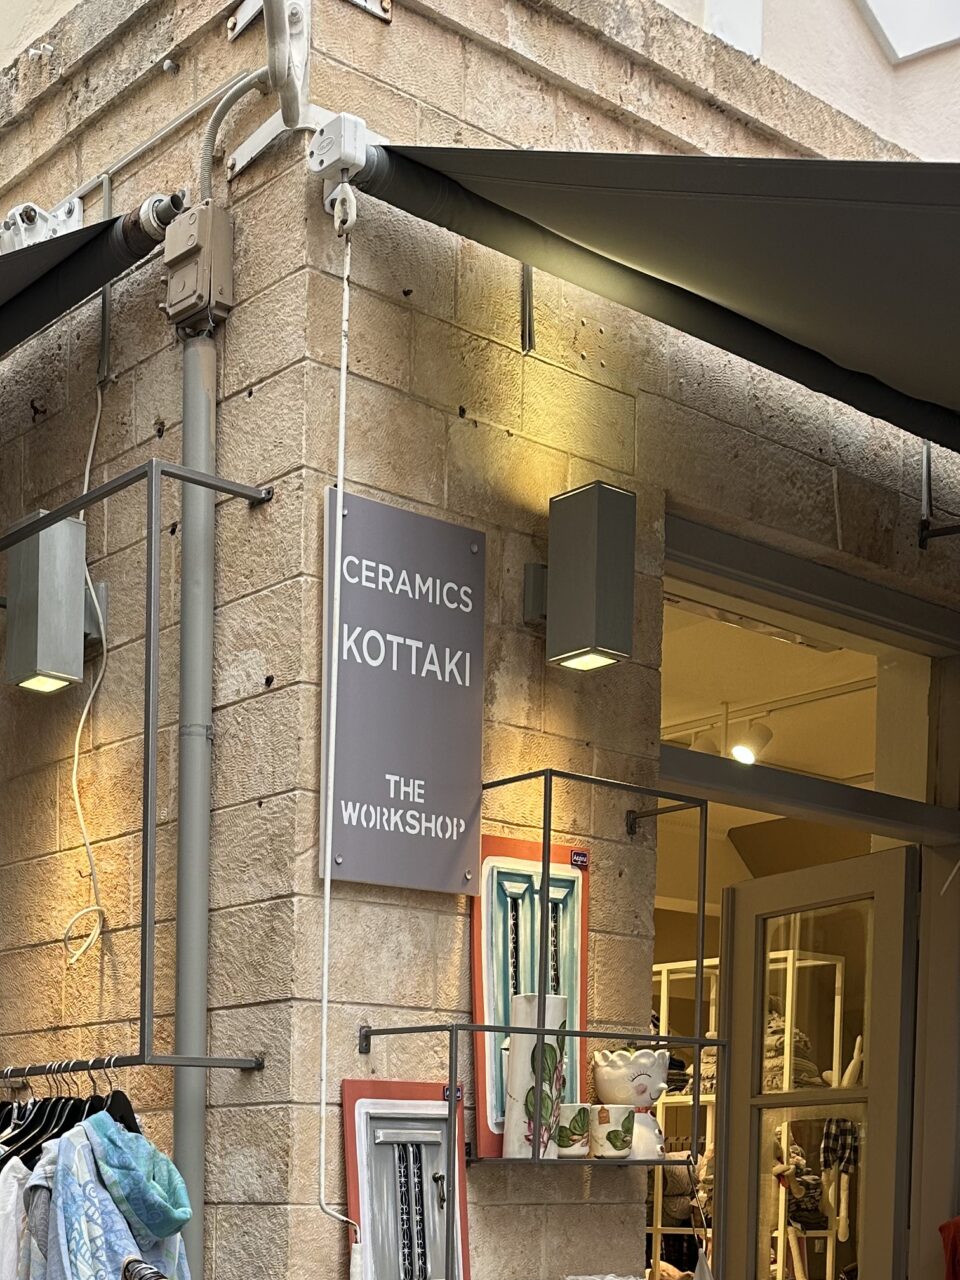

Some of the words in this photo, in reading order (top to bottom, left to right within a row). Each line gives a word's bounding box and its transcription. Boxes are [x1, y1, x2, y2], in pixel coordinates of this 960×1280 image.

[343, 555, 473, 613] CERAMICS
[343, 624, 471, 687] KOTTAKI
[385, 774, 425, 803] THE
[341, 800, 465, 840] WORKSHOP
